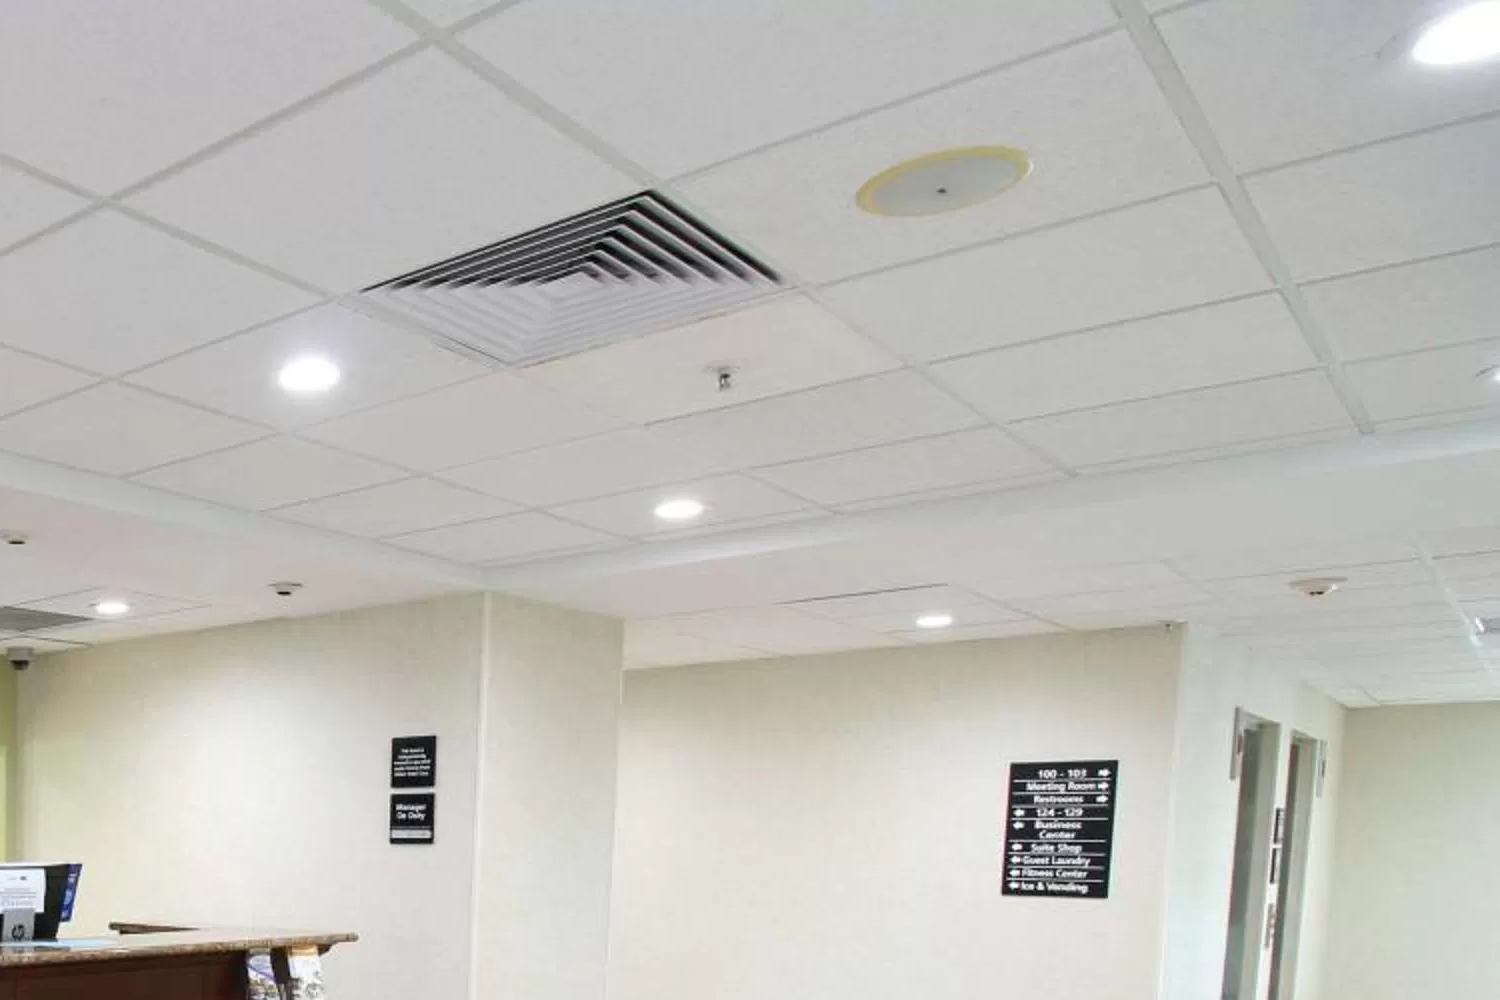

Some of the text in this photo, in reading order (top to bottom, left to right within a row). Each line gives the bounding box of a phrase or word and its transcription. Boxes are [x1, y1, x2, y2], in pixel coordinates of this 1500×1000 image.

[1038, 769, 1057, 779] 100
[1026, 781, 1096, 793] Meeting Room
[1033, 795, 1084, 804] Restrooms
[1036, 808, 1055, 817] 124
[1034, 821, 1082, 829] Business
[1039, 829, 1076, 839] Center
[1031, 843, 1083, 855] Suite Shop
[1023, 855, 1091, 868] Guest Laundry
[1055, 868, 1088, 879] Center
[1021, 881, 1034, 891] Ice
[1046, 881, 1088, 894] Vending
